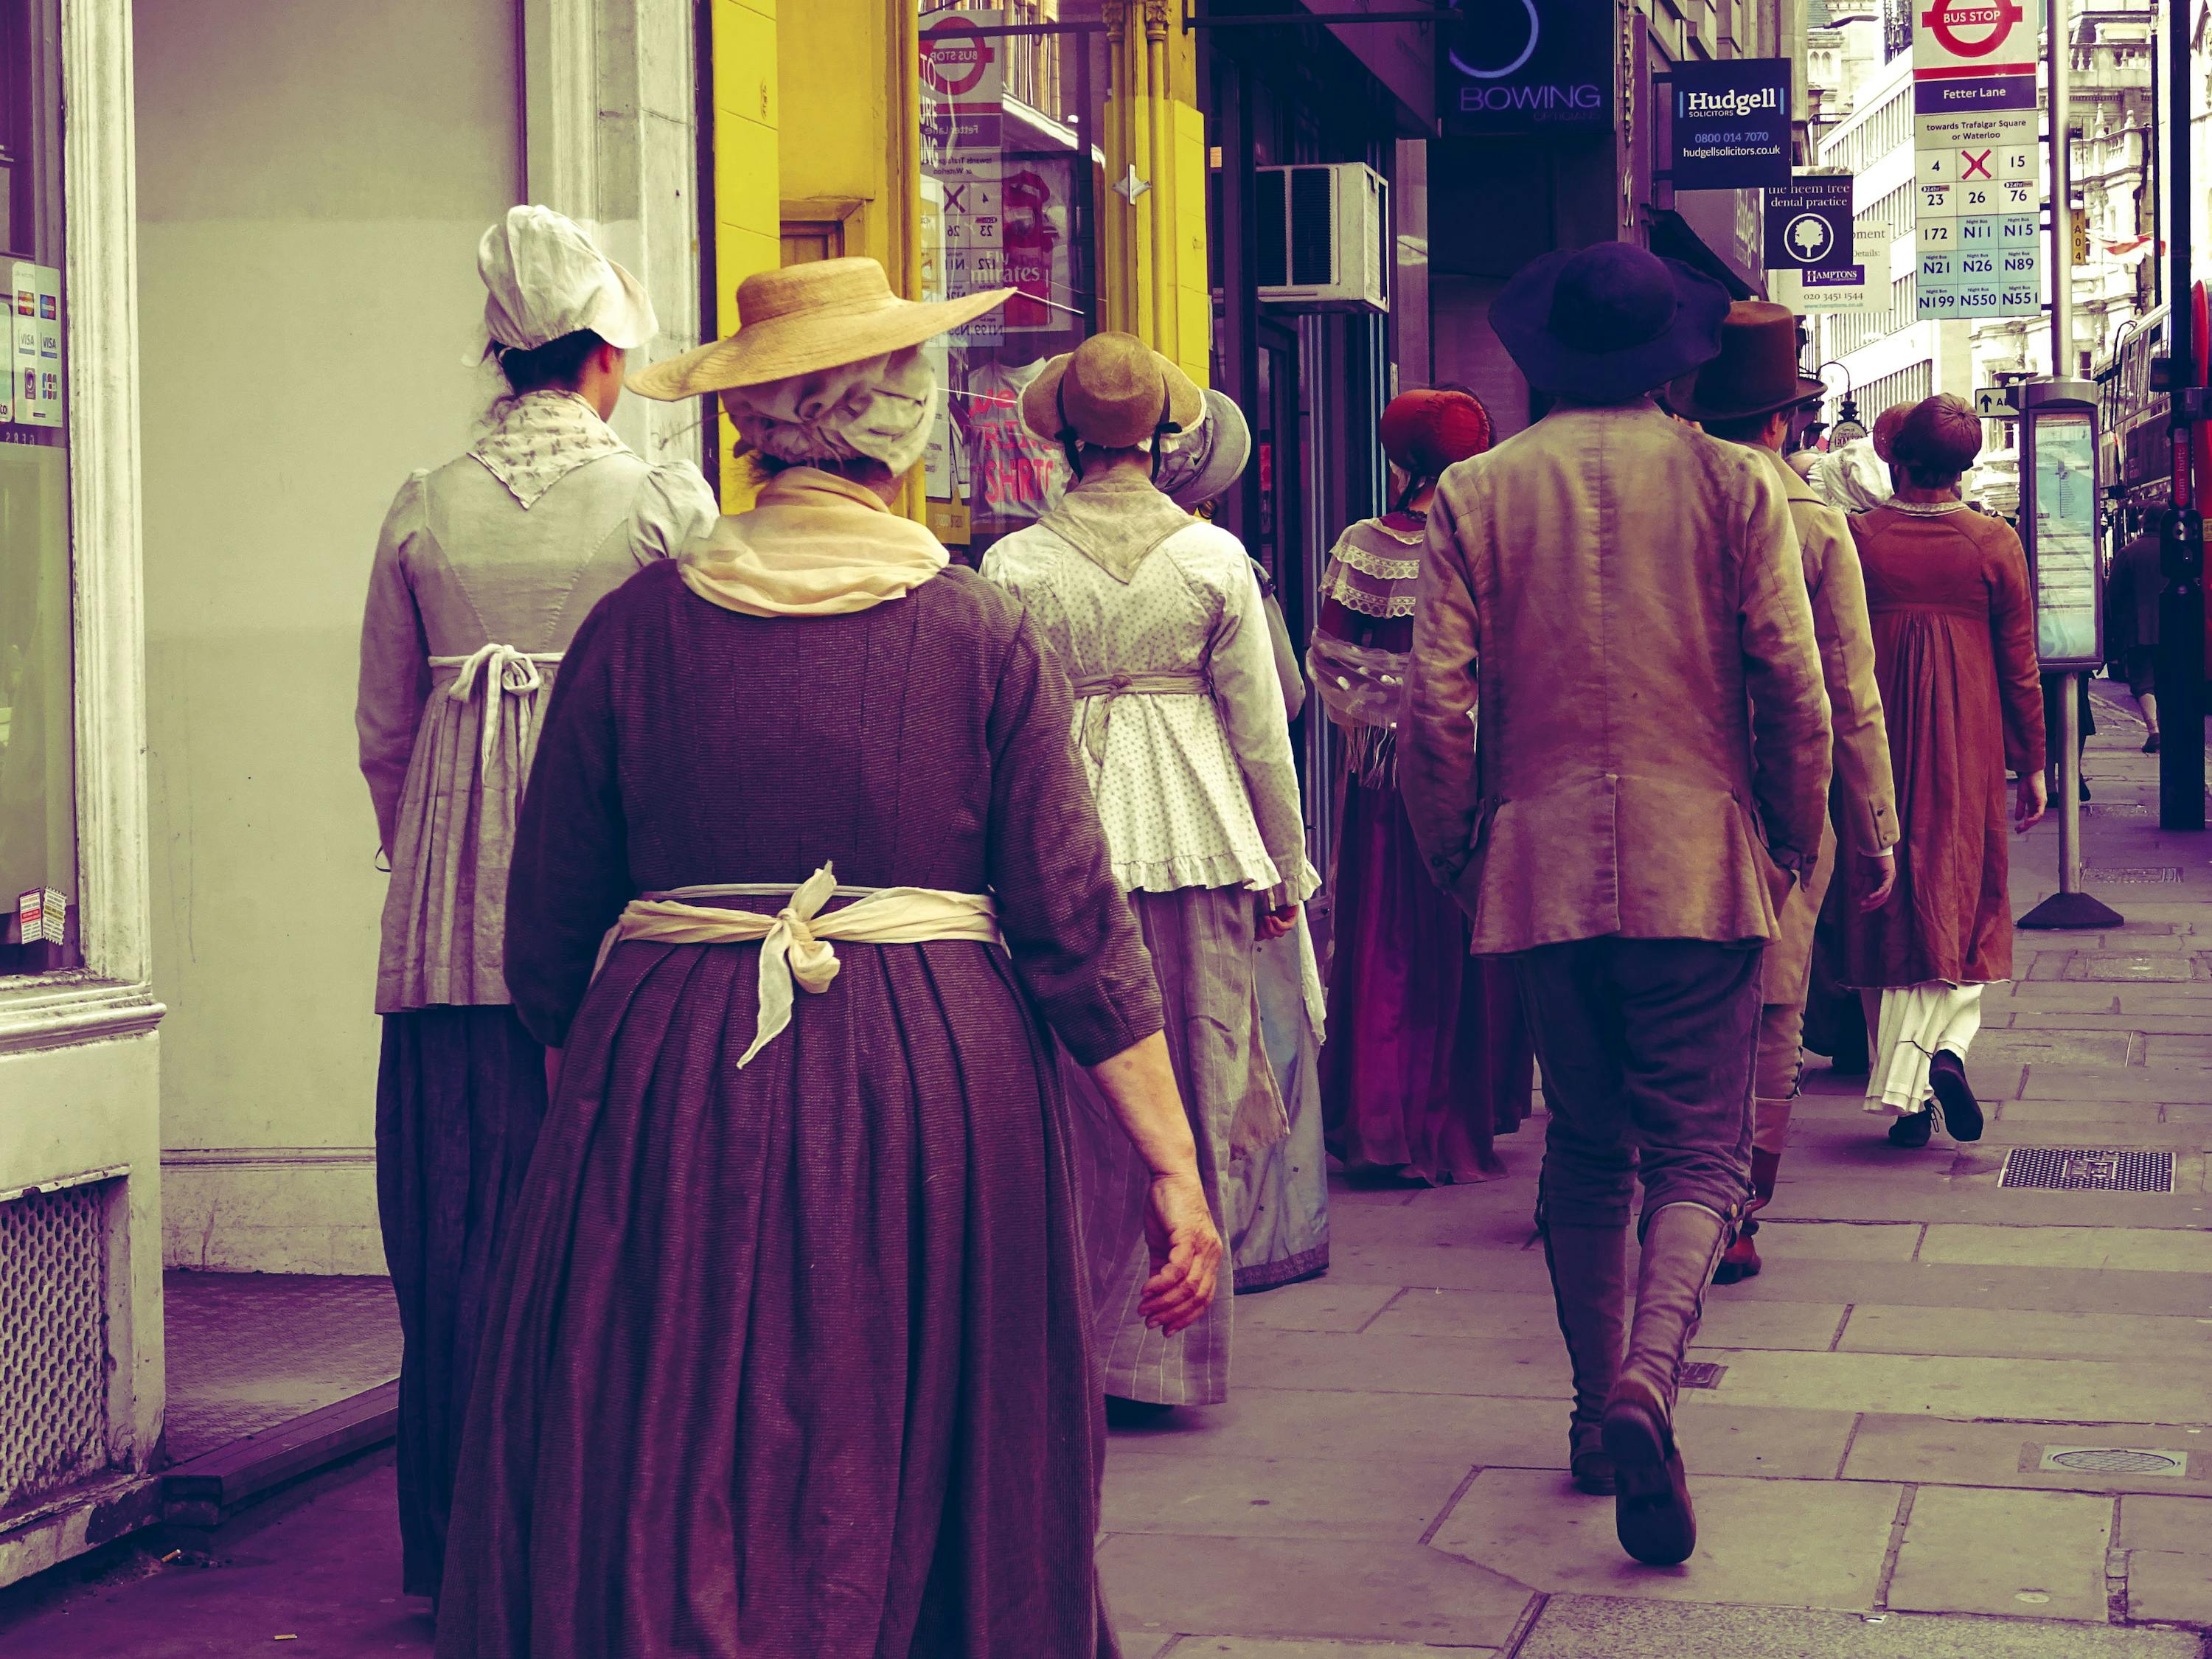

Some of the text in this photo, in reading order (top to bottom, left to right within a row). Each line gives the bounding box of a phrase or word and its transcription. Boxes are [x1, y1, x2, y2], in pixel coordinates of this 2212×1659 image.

[1944, 10, 2000, 24] BUS STOP
[1461, 85, 1601, 111] BOWING
[1944, 88, 2006, 99] Fetter Lane
[1688, 88, 1776, 116] Hudgell
[1927, 119, 2026, 131] towards Trafalgar Square
[1695, 131, 1769, 143] 0800 014 7070
[1963, 132, 2000, 140] Waterloo
[1683, 145, 1781, 159] hudgellsolicitors.co.uk
[1931, 160, 1940, 172] 4
[2010, 156, 2025, 167] 15
[1827, 184, 1850, 193] tree
[1927, 194, 1944, 206] 23
[1969, 192, 1986, 204] 26
[2011, 189, 2027, 201] 76
[1771, 196, 1847, 209] dental practice
[1924, 228, 1947, 240] 172
[1964, 226, 1991, 238] N11
[2004, 224, 2033, 237] N15
[1924, 262, 1950, 274] N21
[1964, 260, 1992, 273] N26
[2005, 258, 2034, 271] N89
[1806, 270, 1857, 282] HAMPTONS
[1823, 293, 1840, 302] 3451
[1844, 292, 1863, 301] 1544
[1919, 296, 1954, 309] N199
[1961, 294, 1996, 306] N550
[2003, 292, 2038, 305] N551
[21, 333, 35, 346] VISA
[43, 336, 56, 349] VISA
